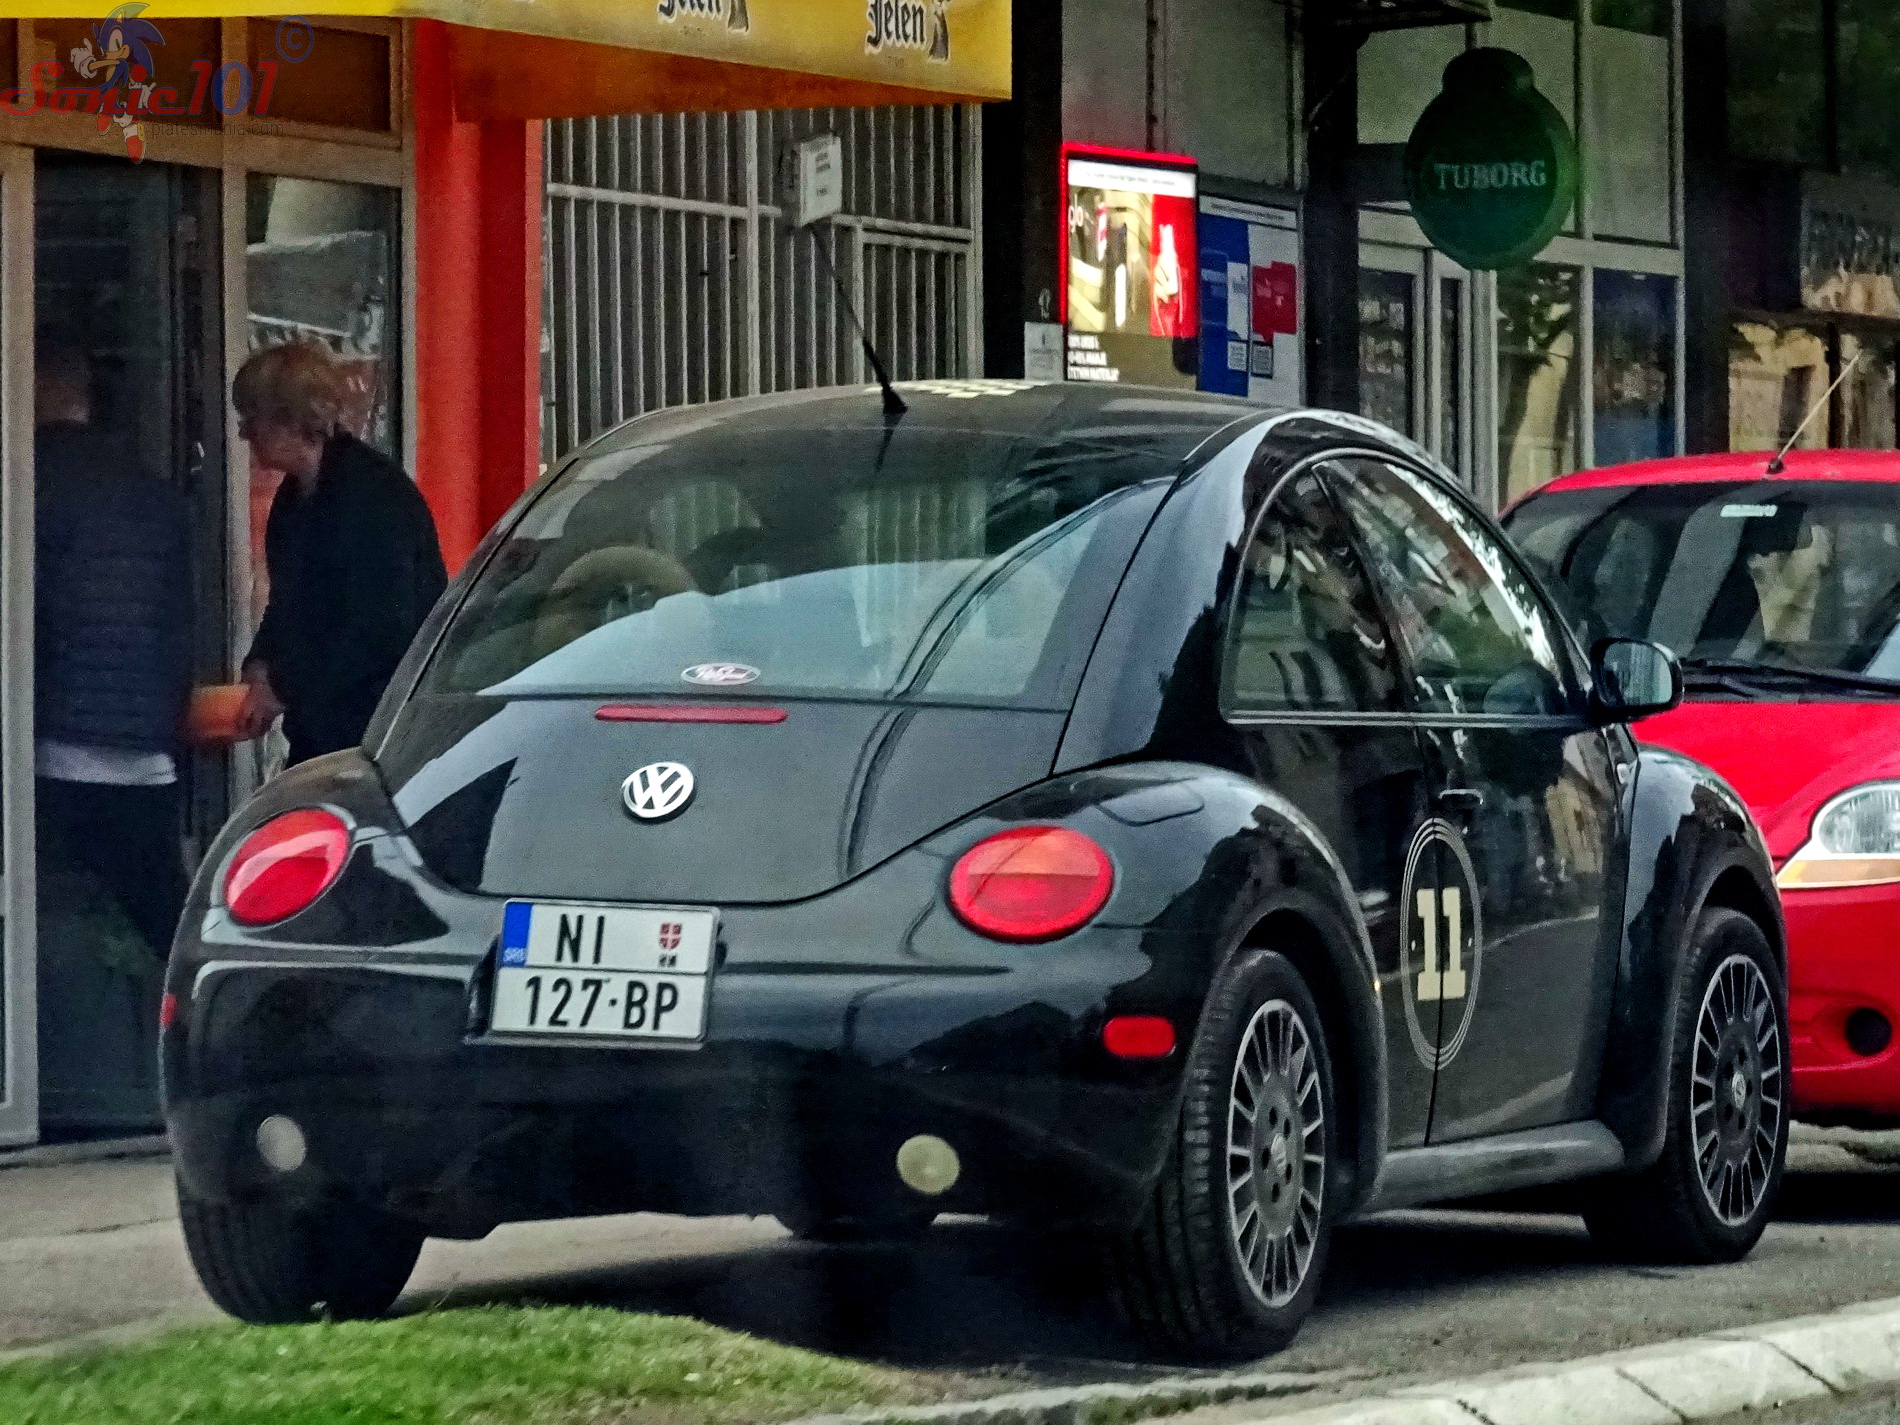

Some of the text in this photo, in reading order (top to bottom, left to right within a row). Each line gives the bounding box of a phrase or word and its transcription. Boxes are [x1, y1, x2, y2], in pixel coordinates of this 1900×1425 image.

[867, 0, 925, 47] Jelen
[1433, 160, 1547, 190] TUBORG
[555, 913, 605, 965] NI
[1417, 887, 1466, 1001] 11
